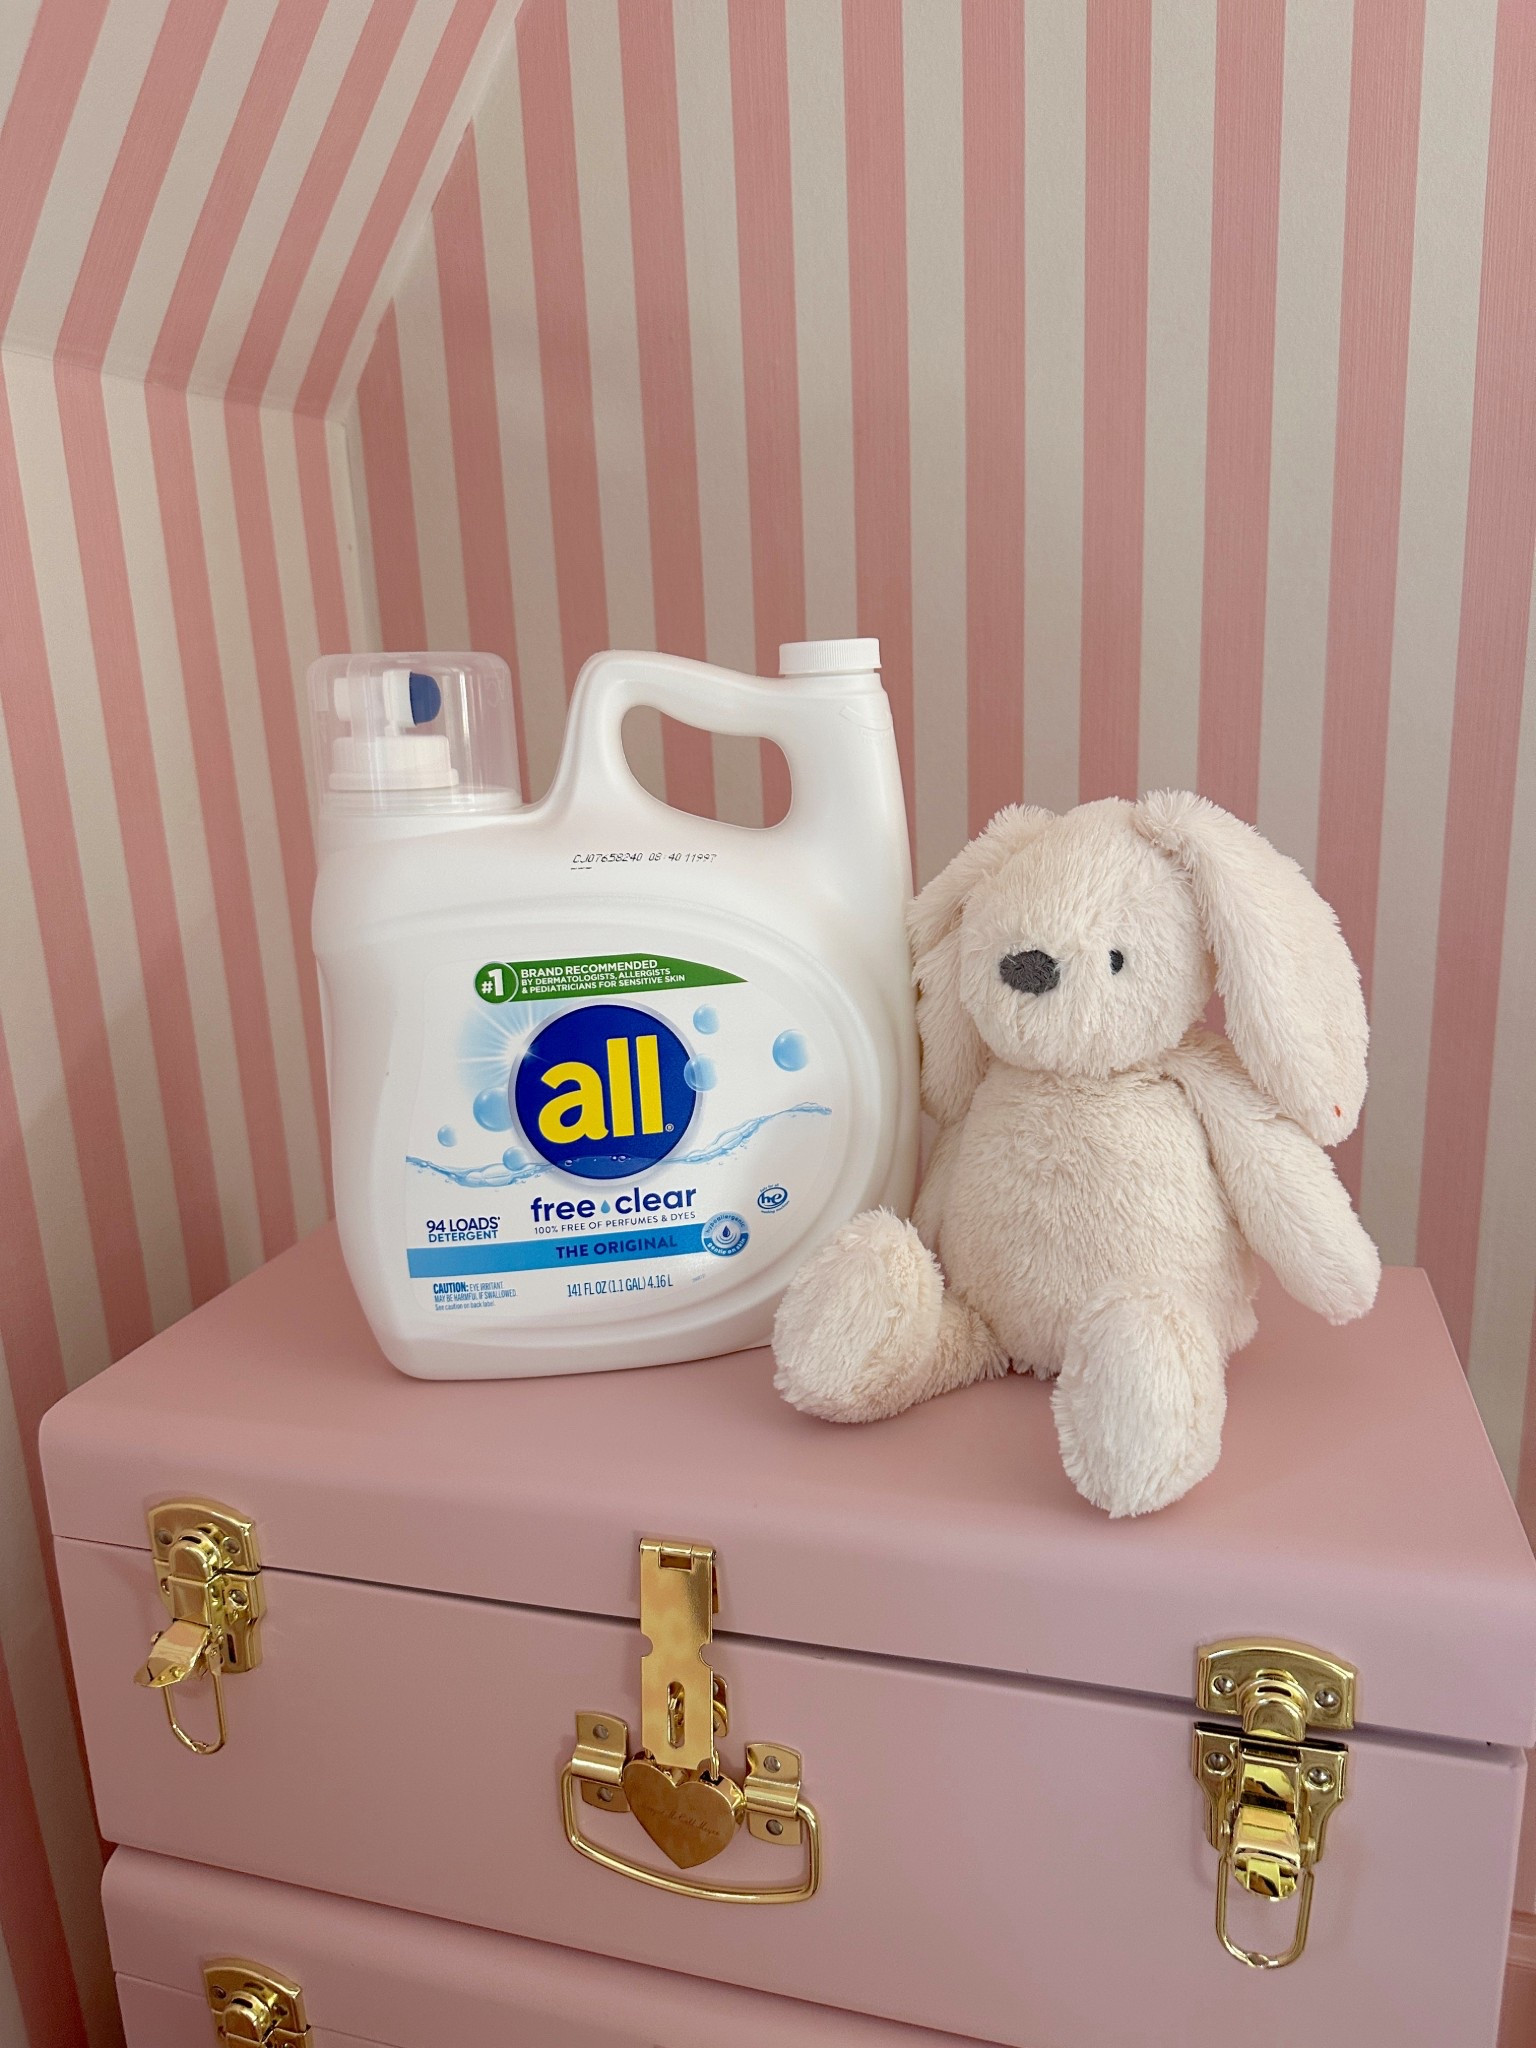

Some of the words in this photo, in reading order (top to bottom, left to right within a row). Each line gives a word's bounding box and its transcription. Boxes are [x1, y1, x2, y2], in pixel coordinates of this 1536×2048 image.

[520, 967, 564, 978] BRAND
[565, 959, 658, 976] RECOMMENDED
[521, 979, 534, 987] BY
[535, 973, 617, 986] DERMATOLOGISTS,
[618, 968, 671, 979] ALLERGISTS
[481, 968, 504, 997] #1
[521, 987, 529, 995] &
[529, 982, 597, 994] PEDIATRICIANS
[598, 979, 618, 988] FOR
[618, 976, 663, 987] SENSITIVE
[664, 974, 686, 983] SKIN
[538, 1034, 664, 1144] all
[530, 1197, 596, 1223] free
[614, 1186, 697, 1215] clear
[426, 1219, 446, 1233] 94
[534, 1225, 558, 1235] 100%
[561, 1222, 586, 1232] FREE
[588, 1220, 602, 1229] OF
[605, 1215, 659, 1227] PERFUMES
[661, 1214, 668, 1222] &
[671, 1211, 696, 1221] DYES
[428, 1229, 498, 1243] DETERGENT
[556, 1243, 589, 1259] THE
[593, 1234, 678, 1255] ORIGINAL
[433, 1281, 469, 1295] CAUTION:
[469, 1283, 480, 1292] EYE
[567, 1284, 581, 1297] 141
[584, 1282, 594, 1295] FL
[595, 1280, 607, 1293] OZ
[608, 1279, 624, 1292] (1.1
[625, 1276, 647, 1291] GAL)
[648, 1275, 667, 1288] 4.16
[667, 1274, 674, 1287] L
[434, 1293, 446, 1303] MAY
[446, 1292, 454, 1302] BE
[478, 1290, 484, 1300] IF
